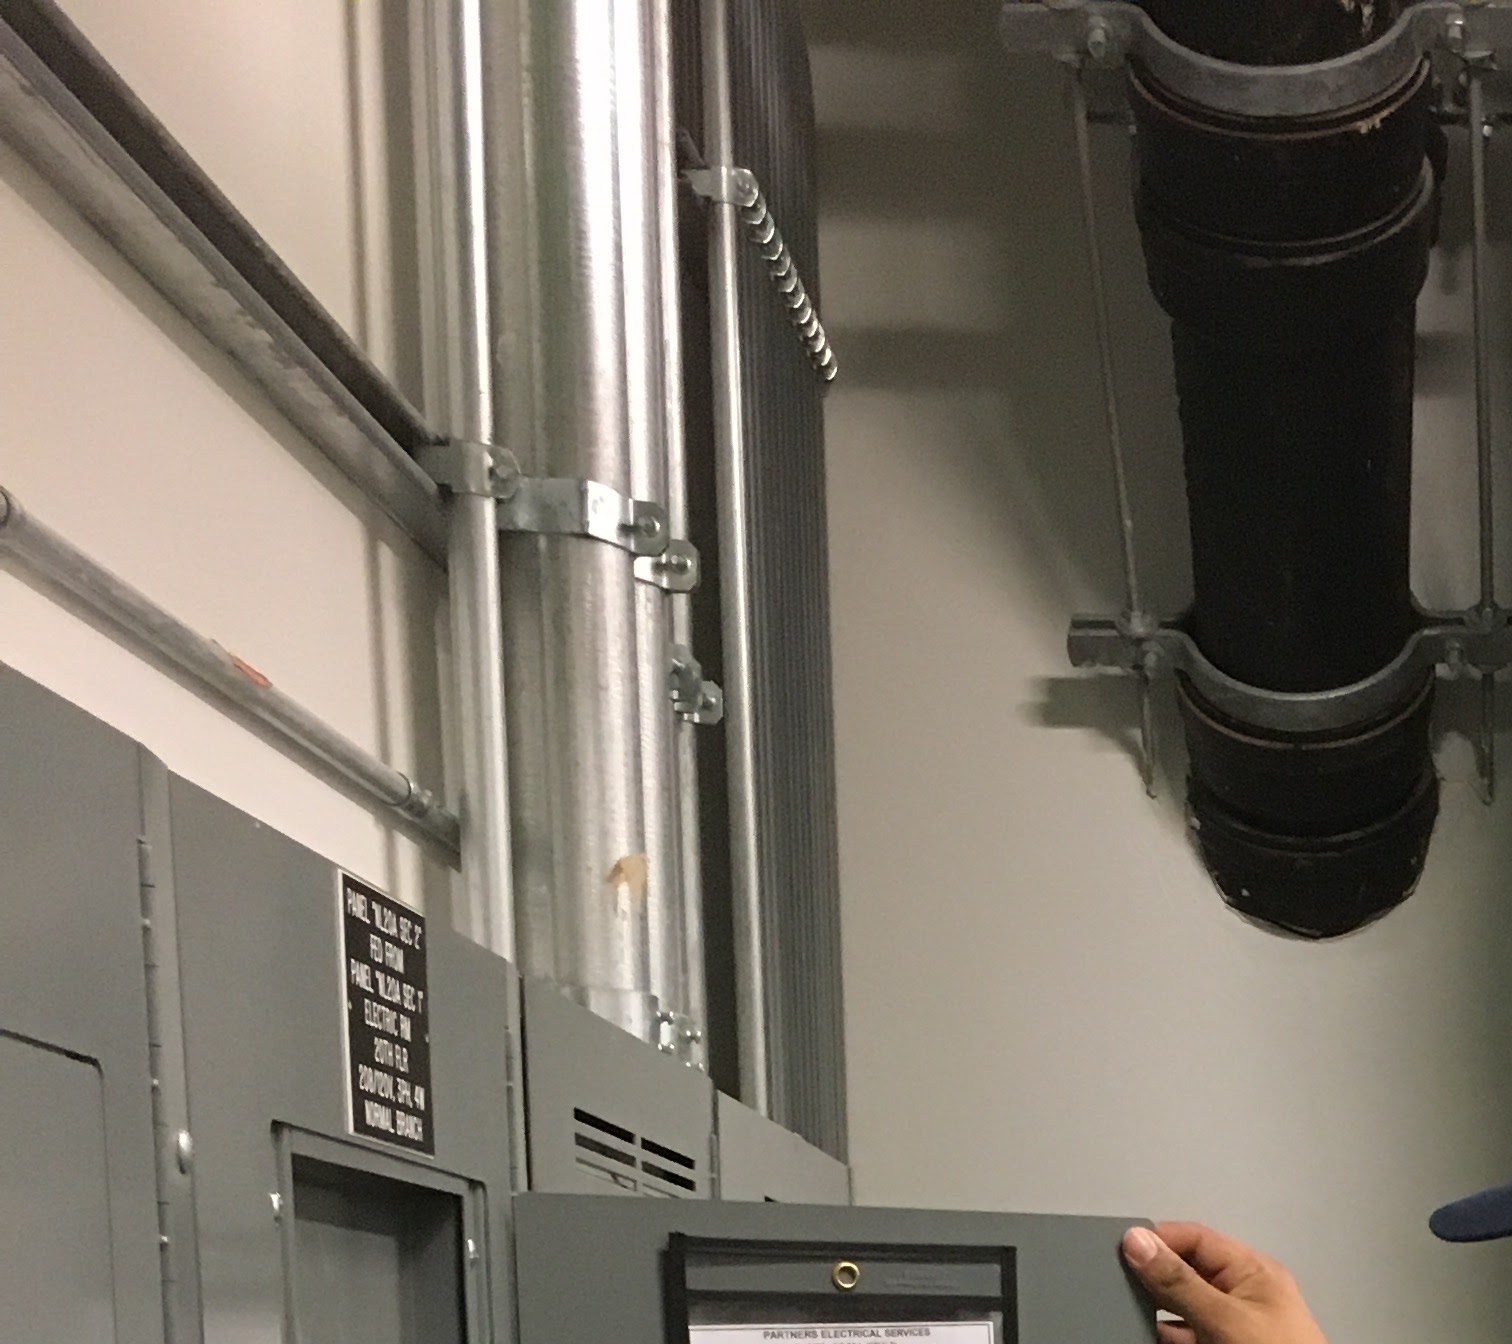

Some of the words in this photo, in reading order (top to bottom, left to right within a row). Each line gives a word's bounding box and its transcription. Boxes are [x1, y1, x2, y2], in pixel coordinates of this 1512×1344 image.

[346, 888, 370, 923] PANEL
[350, 958, 374, 994] PANEL
[364, 998, 399, 1038] ELECTRIC
[763, 1330, 819, 1340] PARTNERS
[820, 1328, 882, 1339] ELECTRICAL
[884, 1327, 931, 1338] SERVICES
